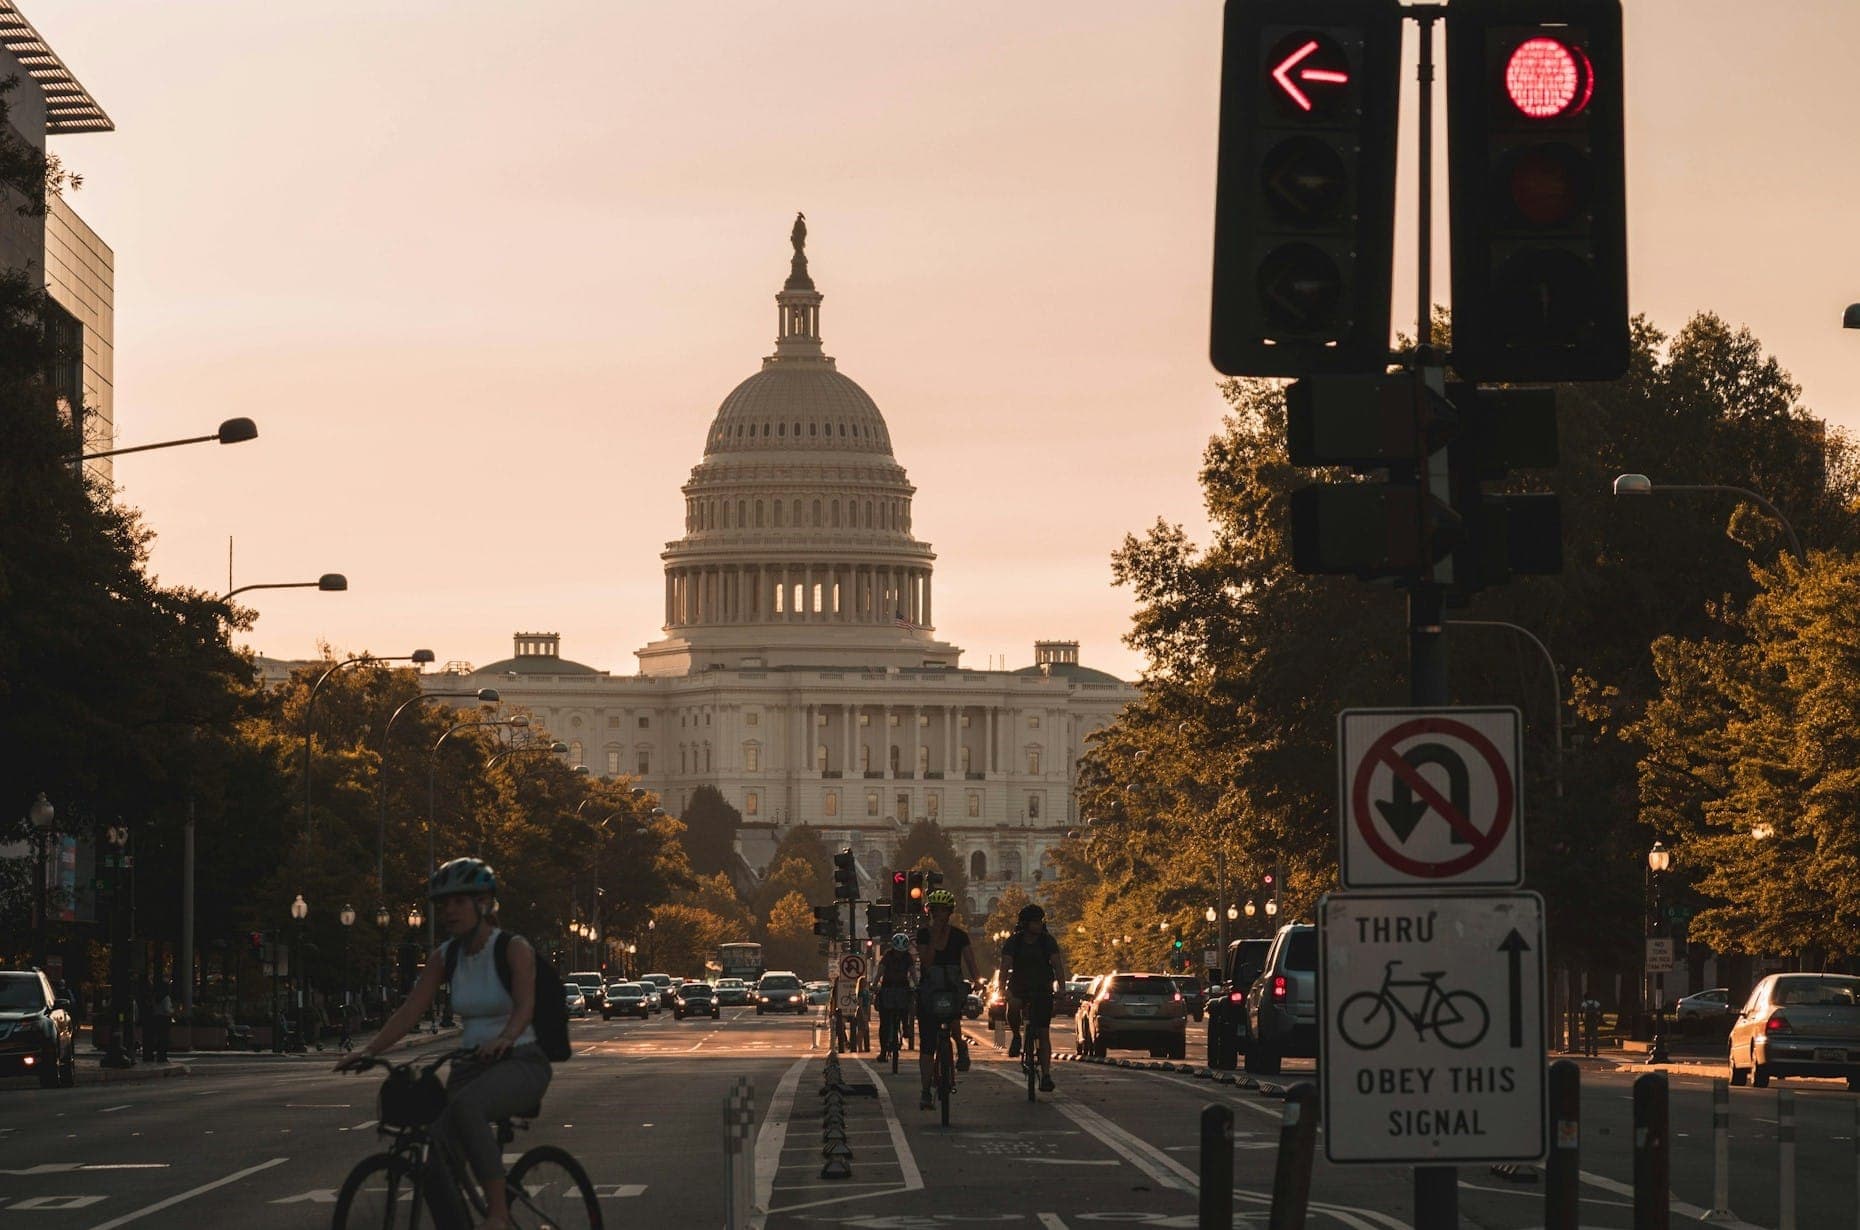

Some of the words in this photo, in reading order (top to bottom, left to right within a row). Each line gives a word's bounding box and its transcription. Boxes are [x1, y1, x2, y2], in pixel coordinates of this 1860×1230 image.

[1356, 916, 1435, 943] THRU
[1357, 1068, 1434, 1094] OBEY
[1449, 1066, 1515, 1093] THIS
[1388, 1109, 1486, 1136] SIGNAL
